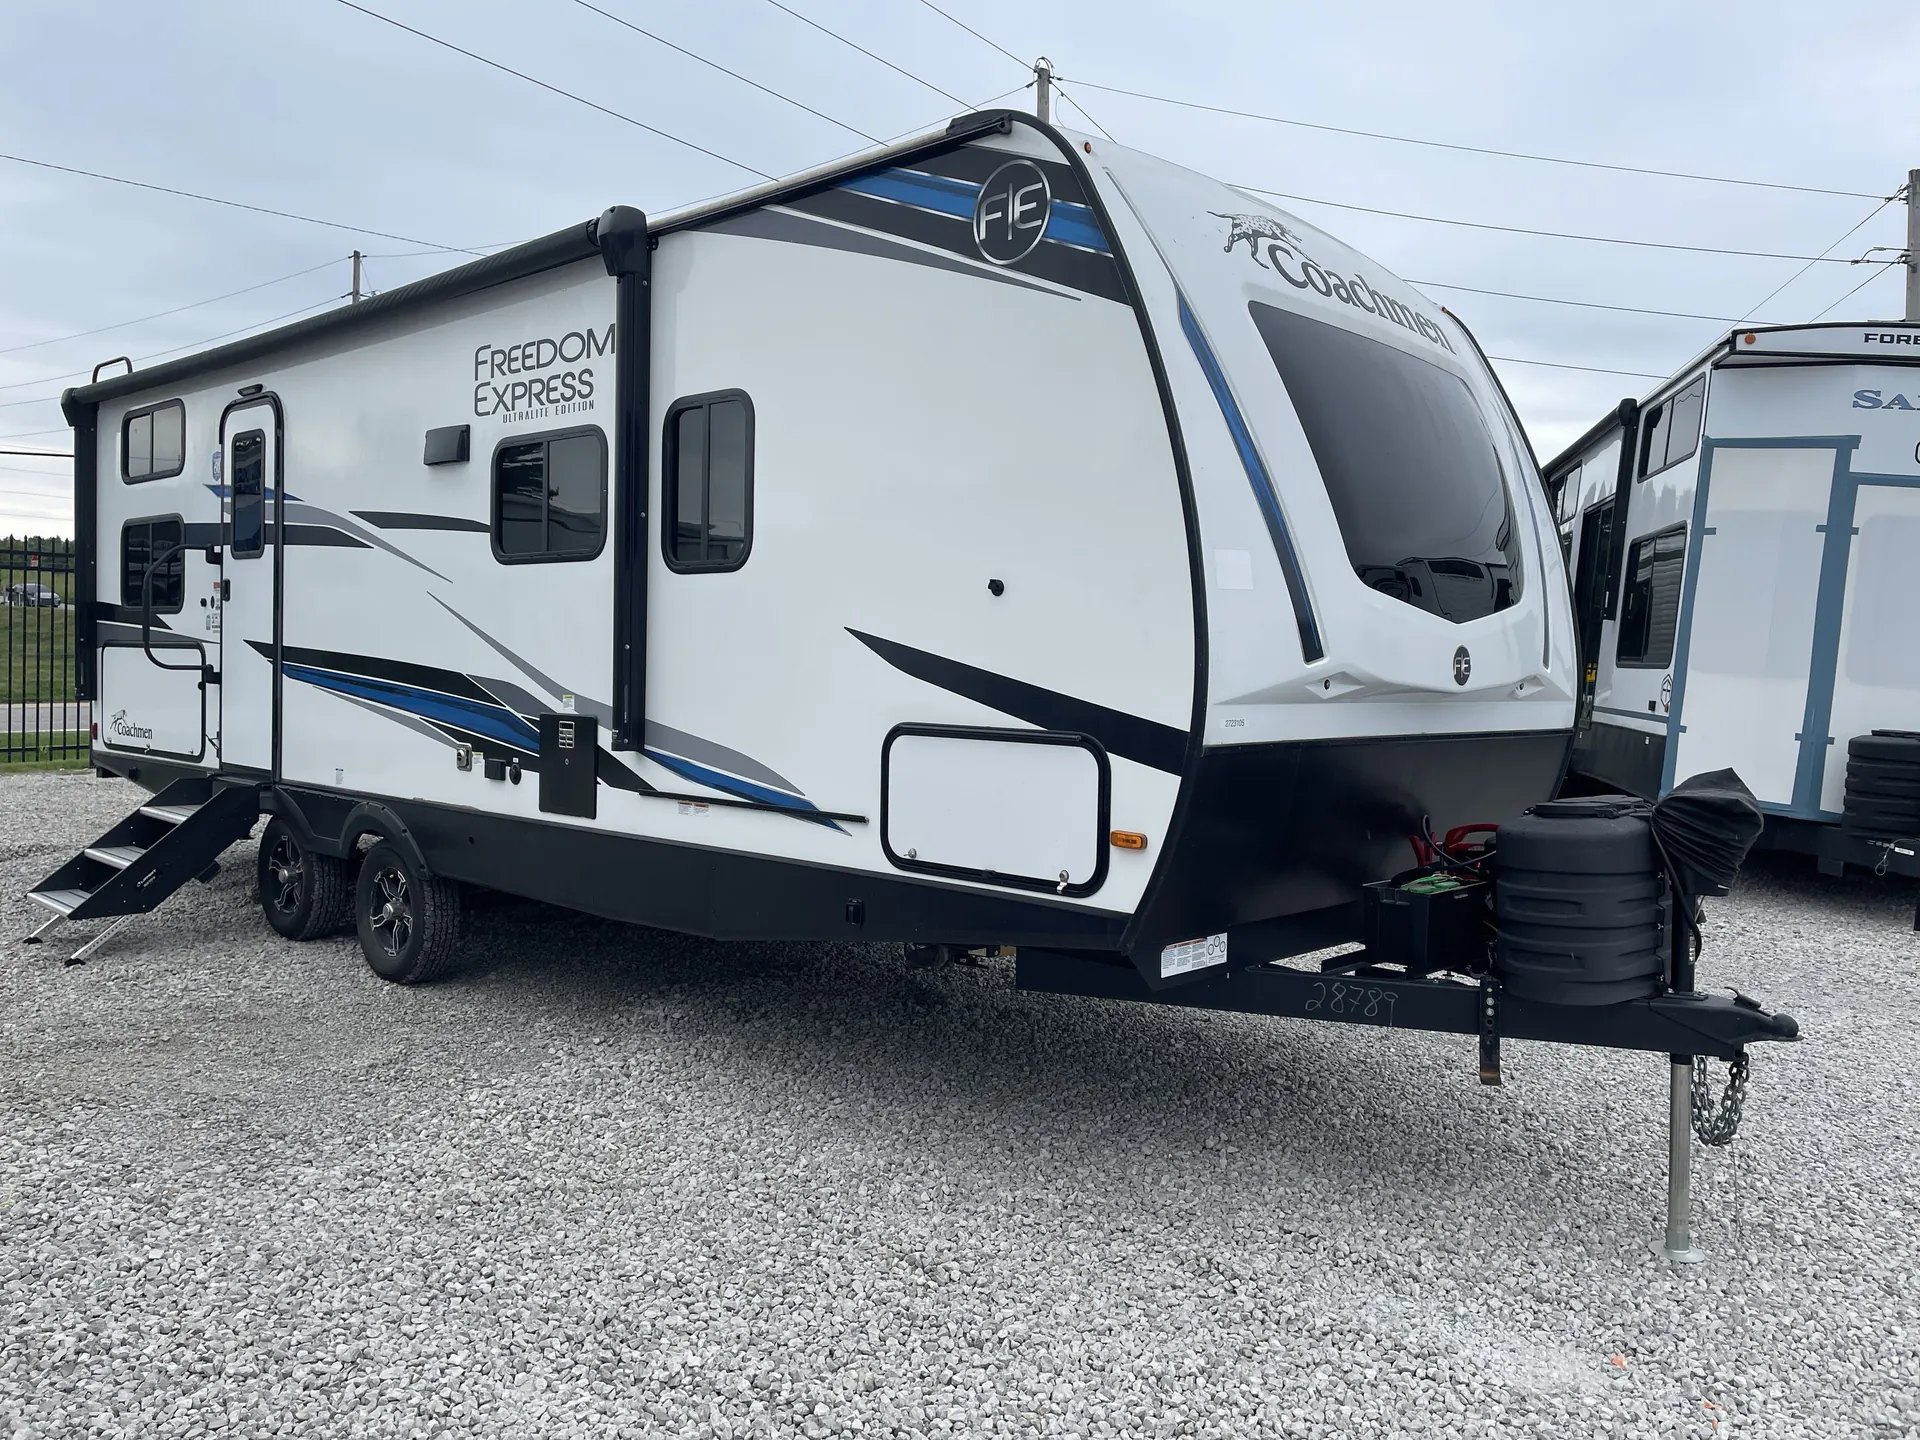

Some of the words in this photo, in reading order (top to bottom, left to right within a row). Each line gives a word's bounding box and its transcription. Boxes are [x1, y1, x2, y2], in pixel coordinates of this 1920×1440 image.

[1268, 244, 1457, 355] Coachmen
[474, 323, 616, 381] FREEDOM
[474, 368, 594, 417] EXPRESS
[502, 407, 549, 424] ULTRALITE
[555, 399, 595, 416] EDITION
[1853, 389, 1920, 410] SA
[117, 722, 153, 740] Coachmen
[1305, 982, 1399, 1027] 28789
